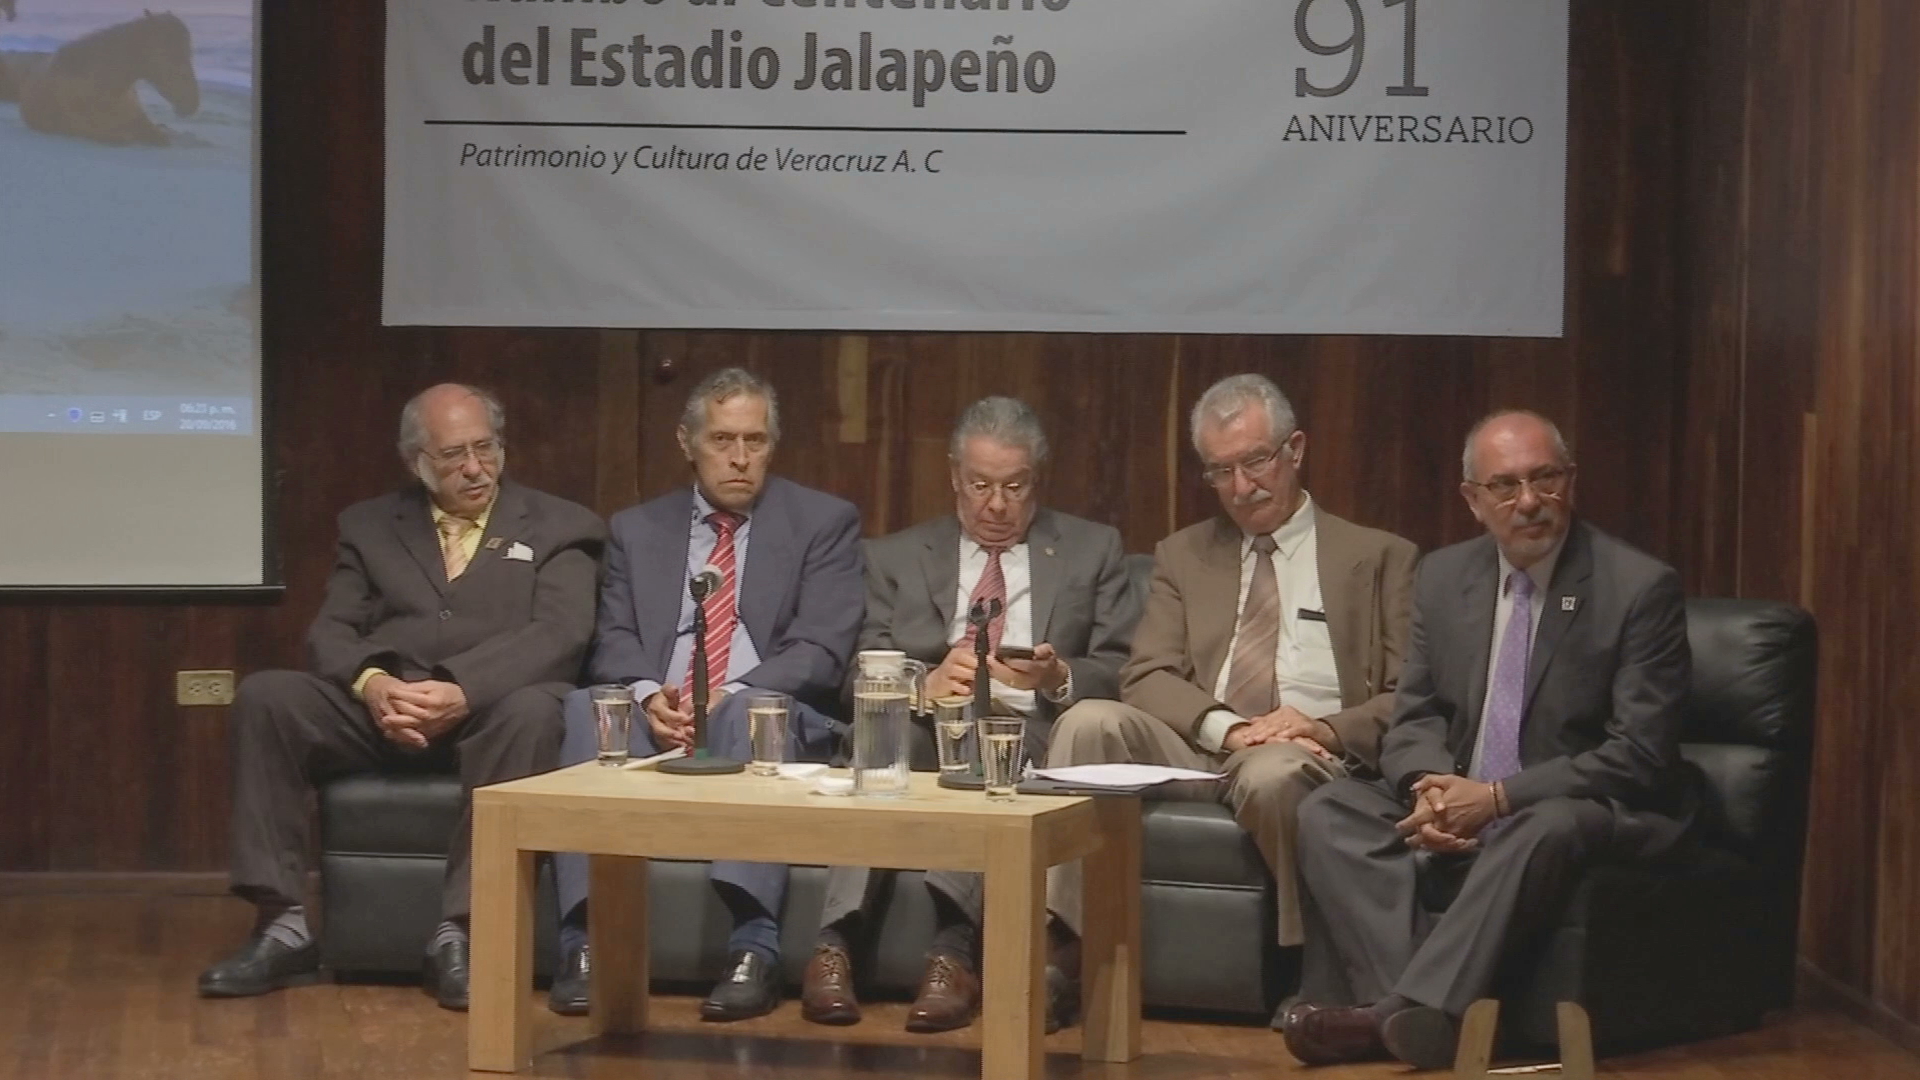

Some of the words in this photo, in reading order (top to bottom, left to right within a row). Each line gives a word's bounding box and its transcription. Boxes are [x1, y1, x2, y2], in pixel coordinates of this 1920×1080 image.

[461, 24, 550, 86] del
[569, 28, 781, 91] Estadio
[793, 31, 1057, 109] Jalapeño
[1293, 0, 1430, 98] 91
[459, 142, 607, 169] Patrimonio
[610, 151, 629, 175] y
[633, 144, 731, 171] Cultura
[735, 145, 768, 172] de
[775, 147, 889, 173] Veracruz
[890, 149, 917, 173] A.
[923, 149, 944, 174] C
[1281, 114, 1535, 145] ANIVERSARIO
